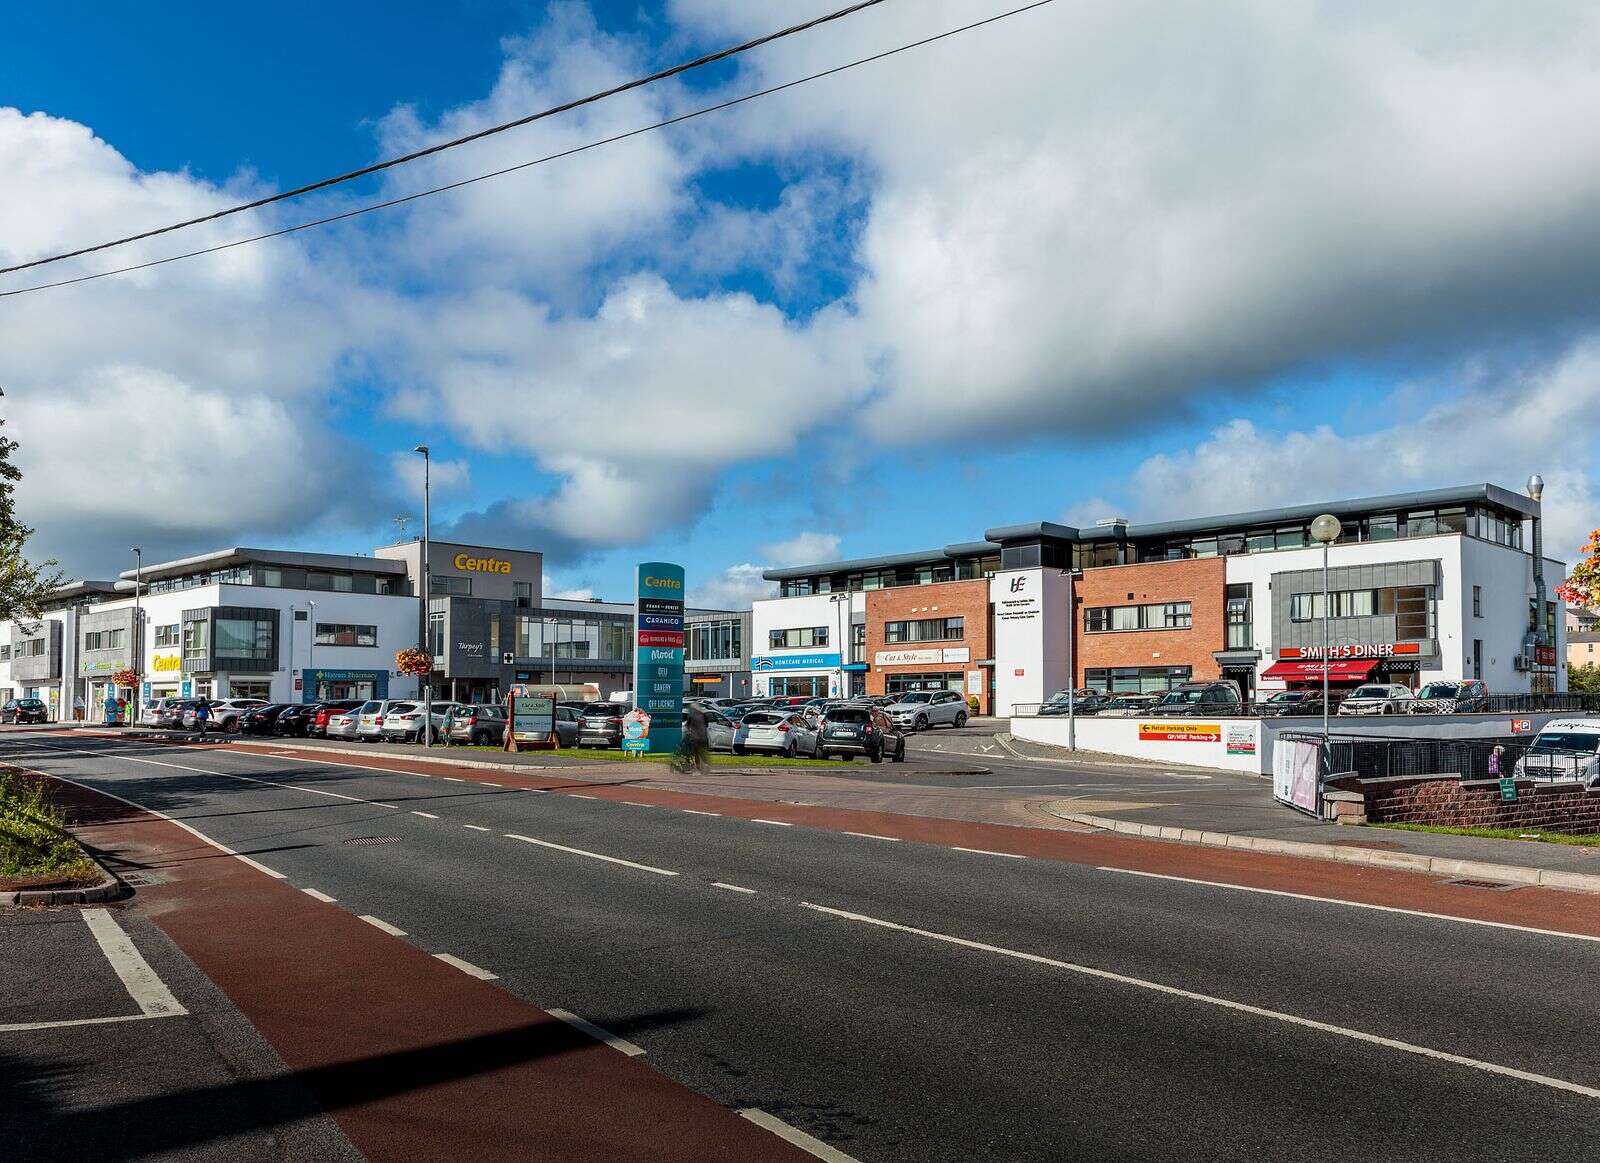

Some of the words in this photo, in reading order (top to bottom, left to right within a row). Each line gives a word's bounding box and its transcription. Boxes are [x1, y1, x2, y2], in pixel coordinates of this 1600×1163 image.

[453, 553, 512, 574] Centra
[644, 576, 681, 589] Centra
[645, 617, 679, 625] CARAMICO
[458, 642, 483, 653] Tarpey's
[1355, 644, 1394, 656] DINER
[884, 654, 896, 662] Cut
[902, 653, 918, 663] Style
[654, 683, 671, 693] BAKERY
